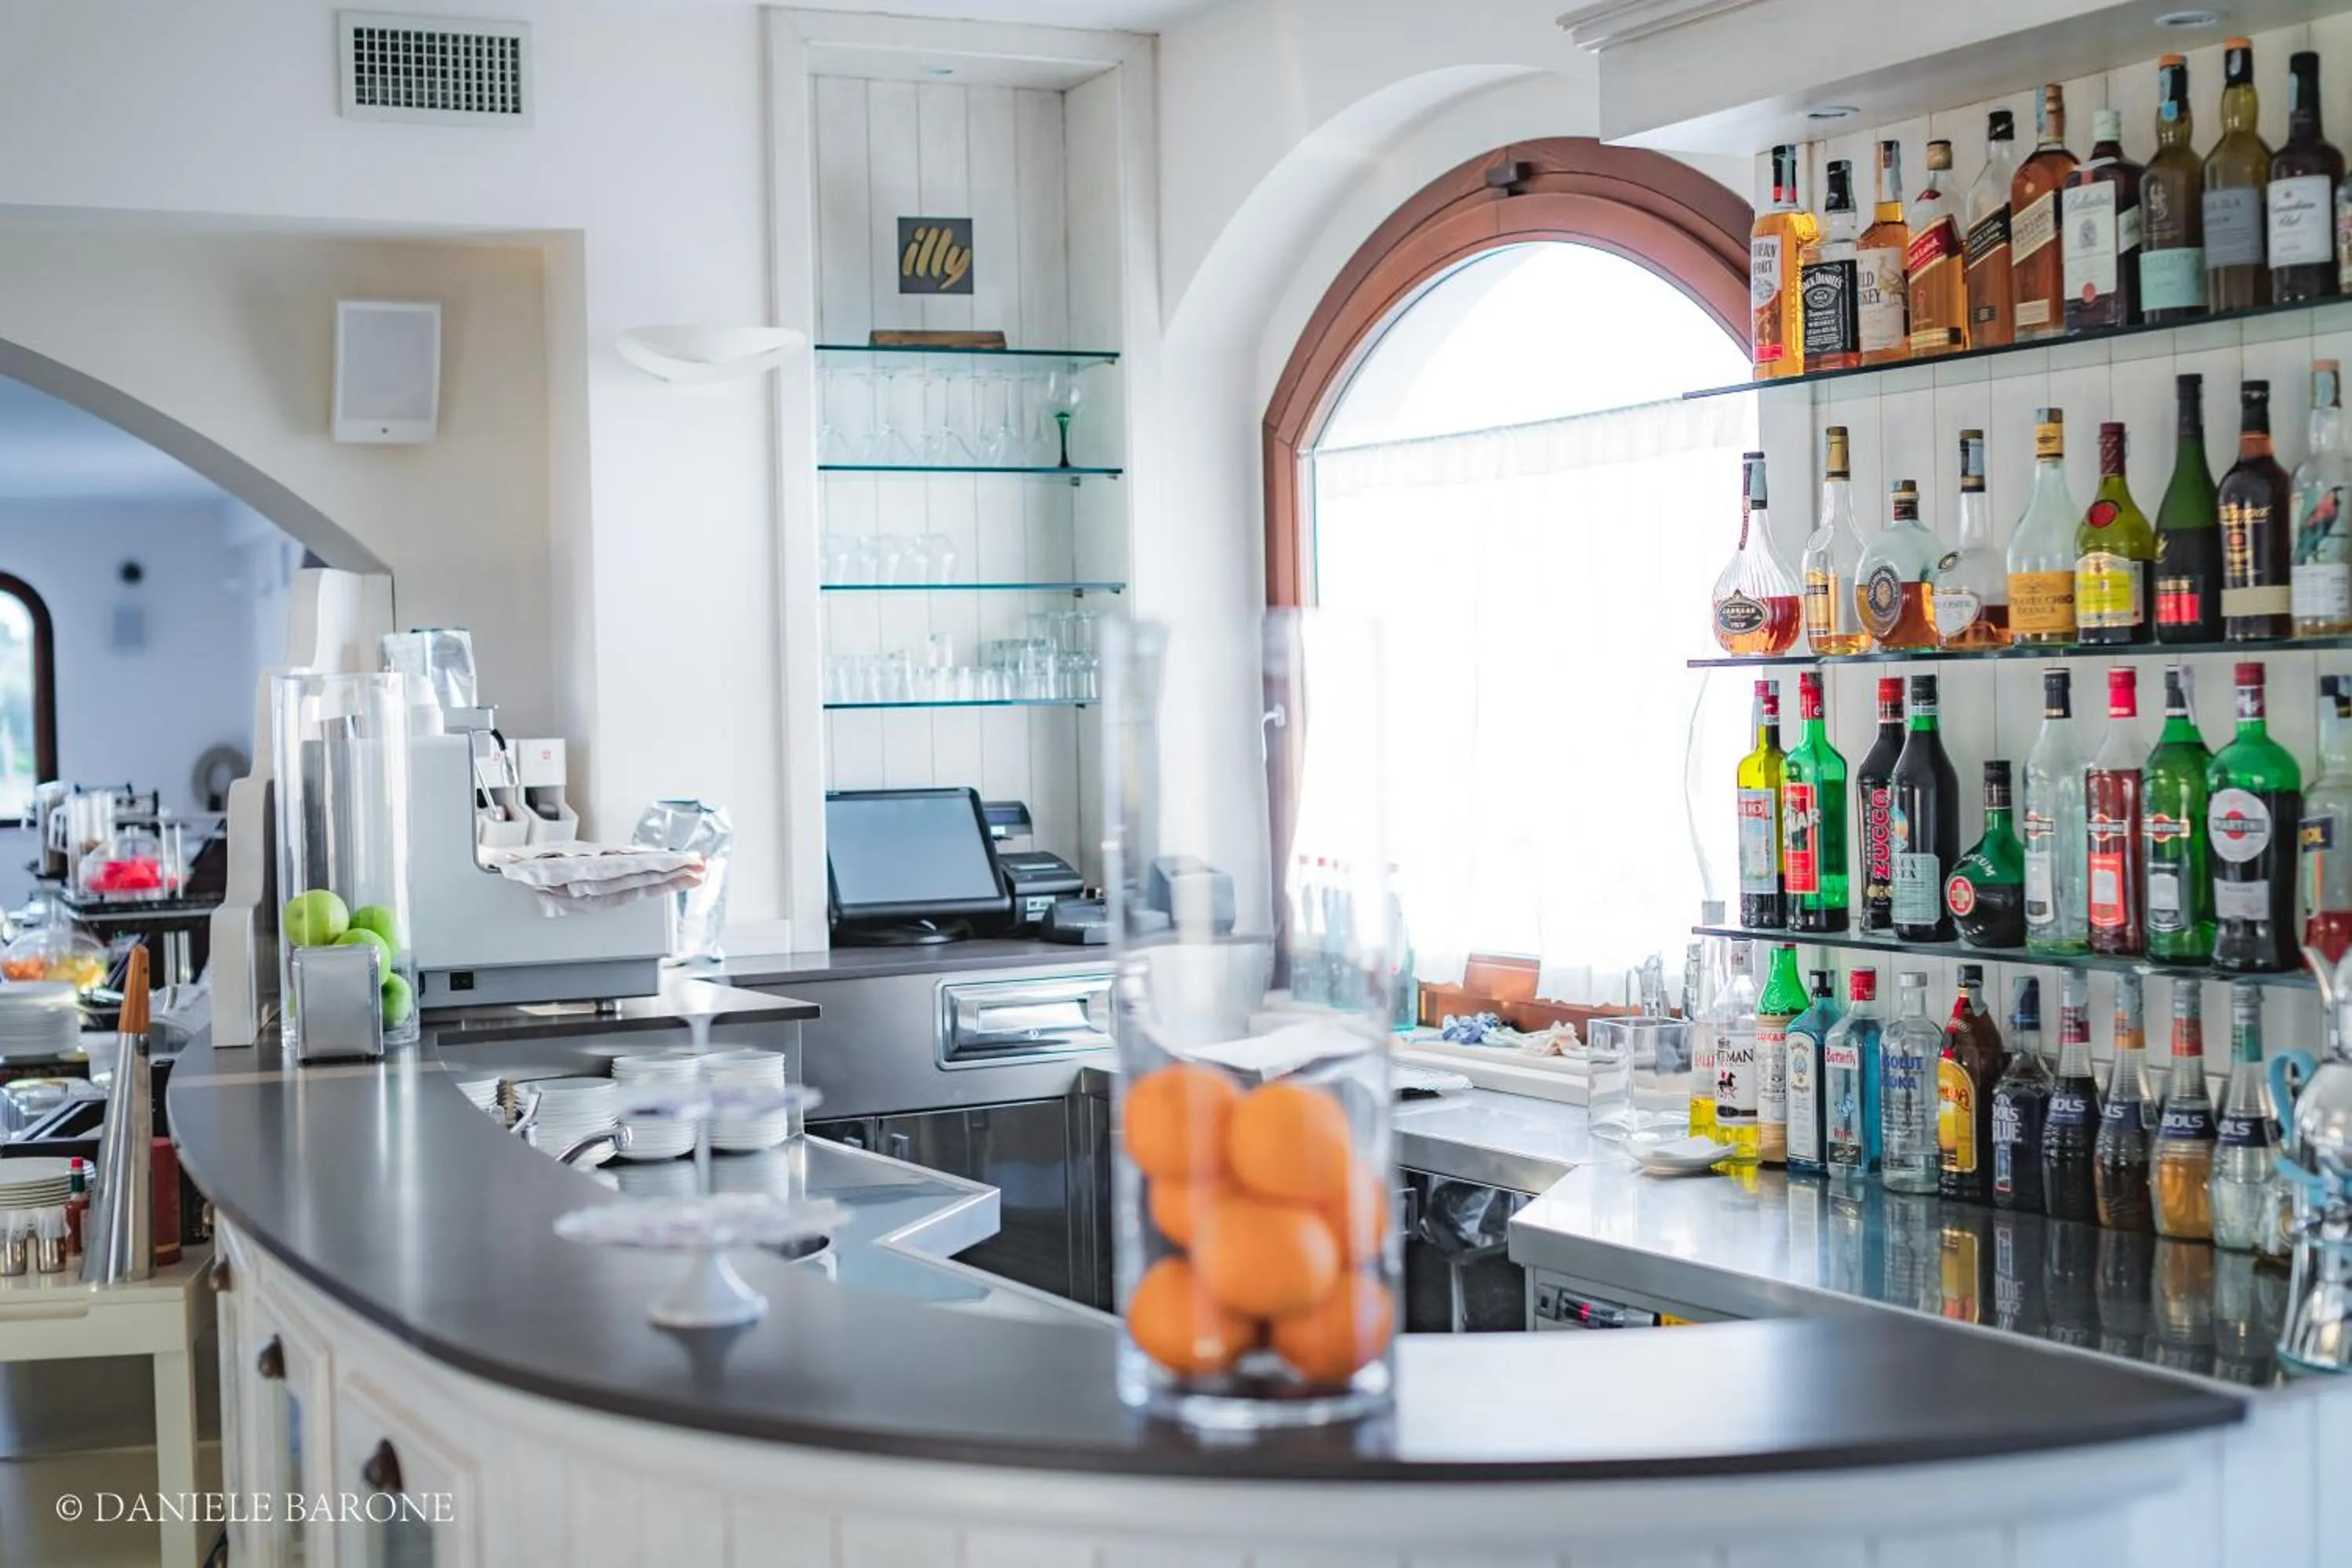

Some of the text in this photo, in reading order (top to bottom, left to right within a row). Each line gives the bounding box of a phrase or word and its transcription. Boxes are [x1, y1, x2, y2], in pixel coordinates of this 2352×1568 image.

[902, 227, 971, 290] illy
[1872, 788, 1890, 880] ZUCCA
[2161, 1113, 2205, 1128] BOLS
